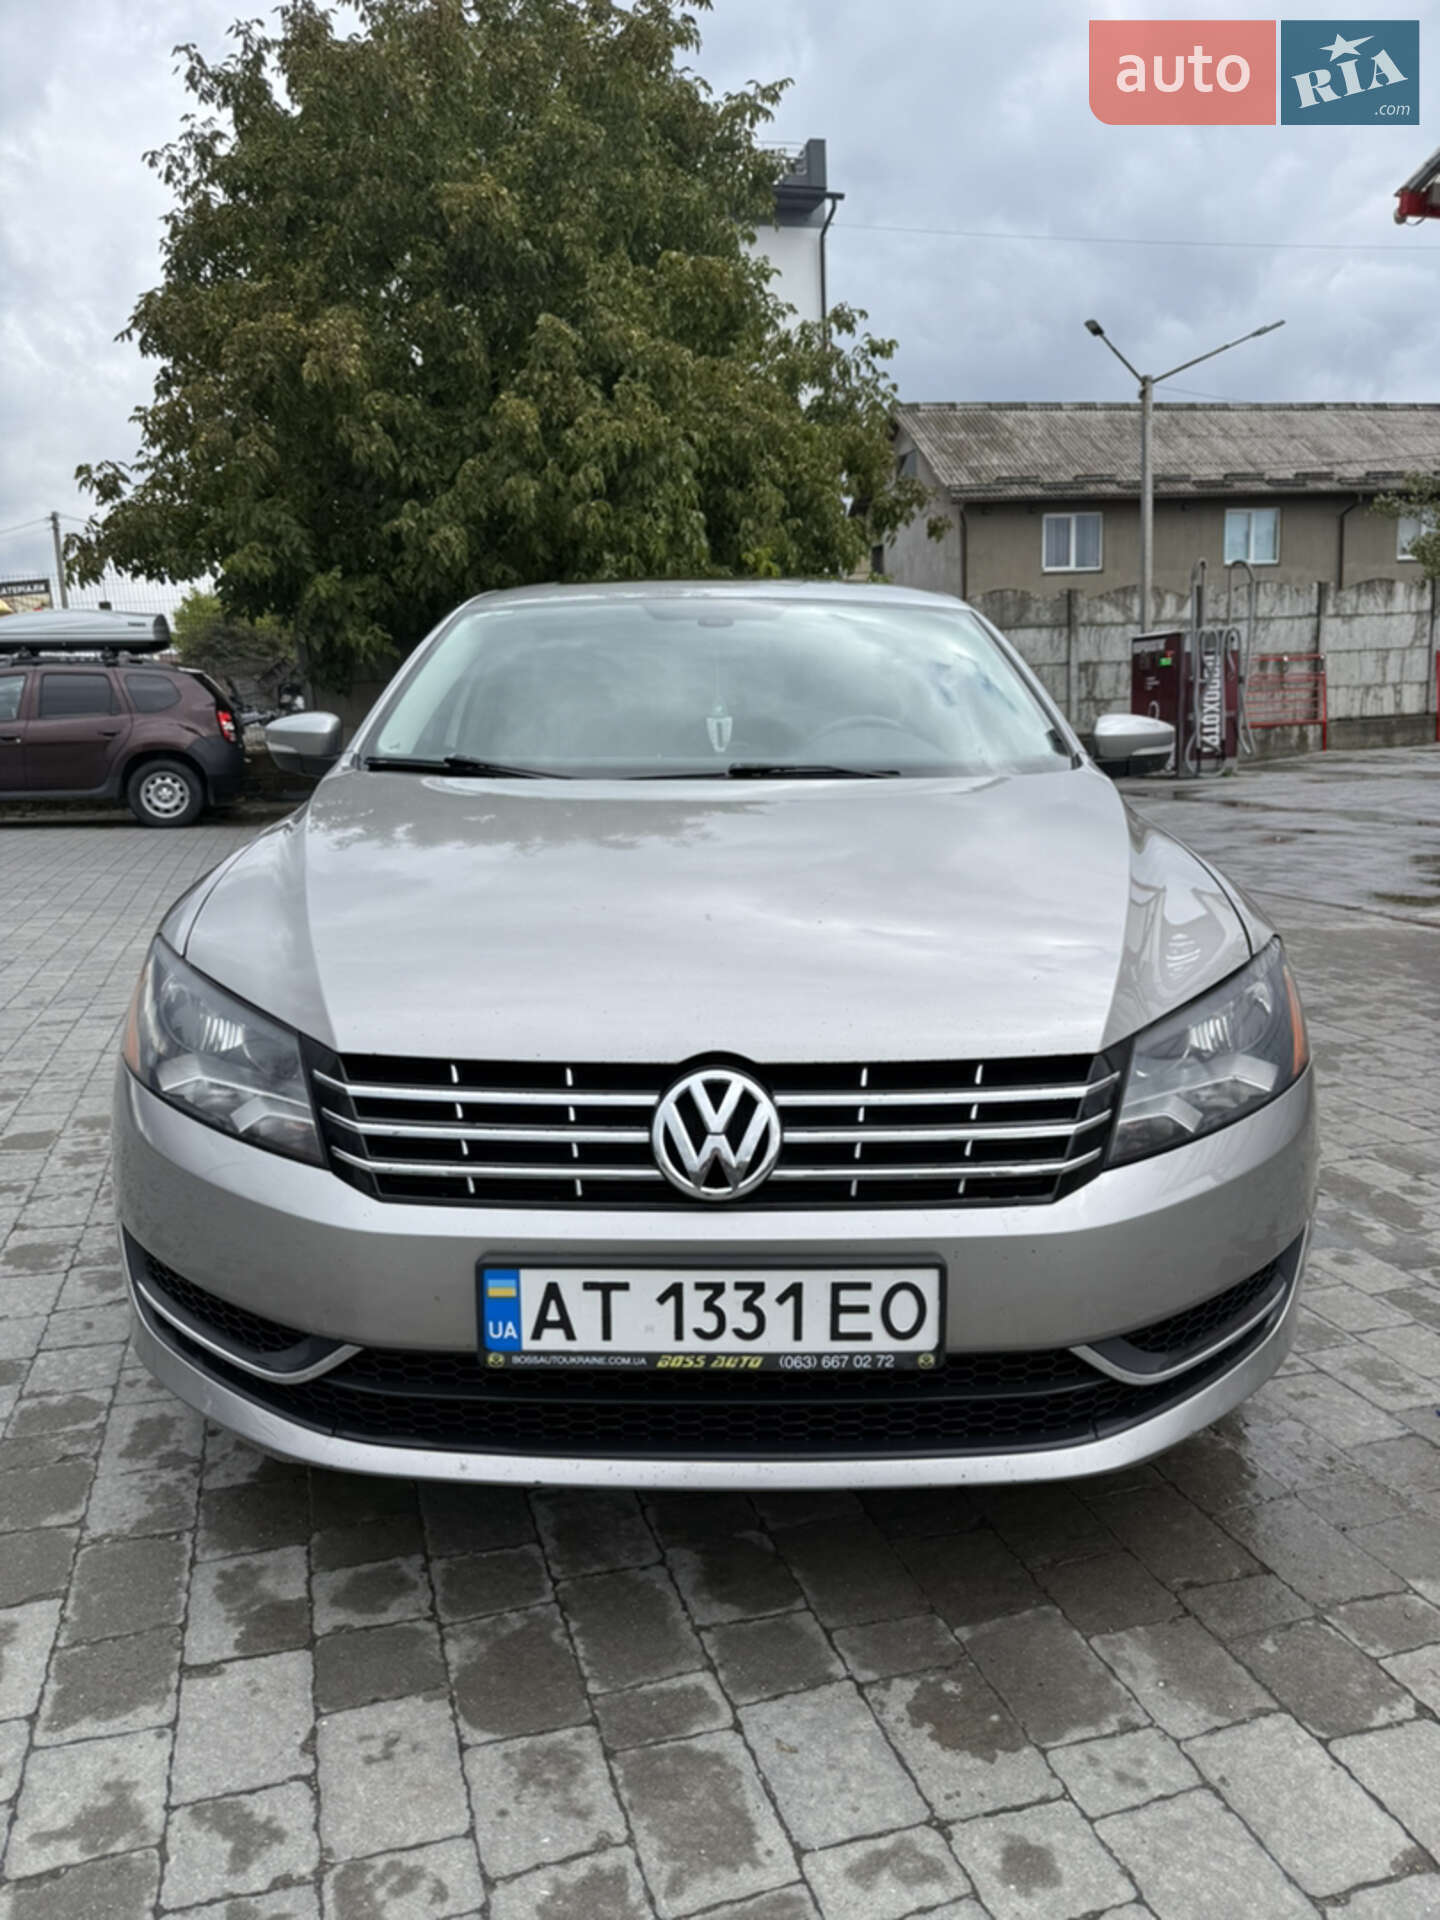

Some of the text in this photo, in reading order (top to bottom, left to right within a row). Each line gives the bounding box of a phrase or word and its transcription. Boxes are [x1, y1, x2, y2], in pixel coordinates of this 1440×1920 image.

[531, 1281, 927, 1342] AT 1331 EO
[488, 1320, 518, 1339] UA
[656, 1355, 706, 1368] BOSS
[710, 1355, 765, 1368] AUTO
[779, 1354, 817, 1369] (063)
[821, 1354, 849, 1368] 667
[853, 1354, 874, 1368] 02
[877, 1354, 895, 1368] 72
